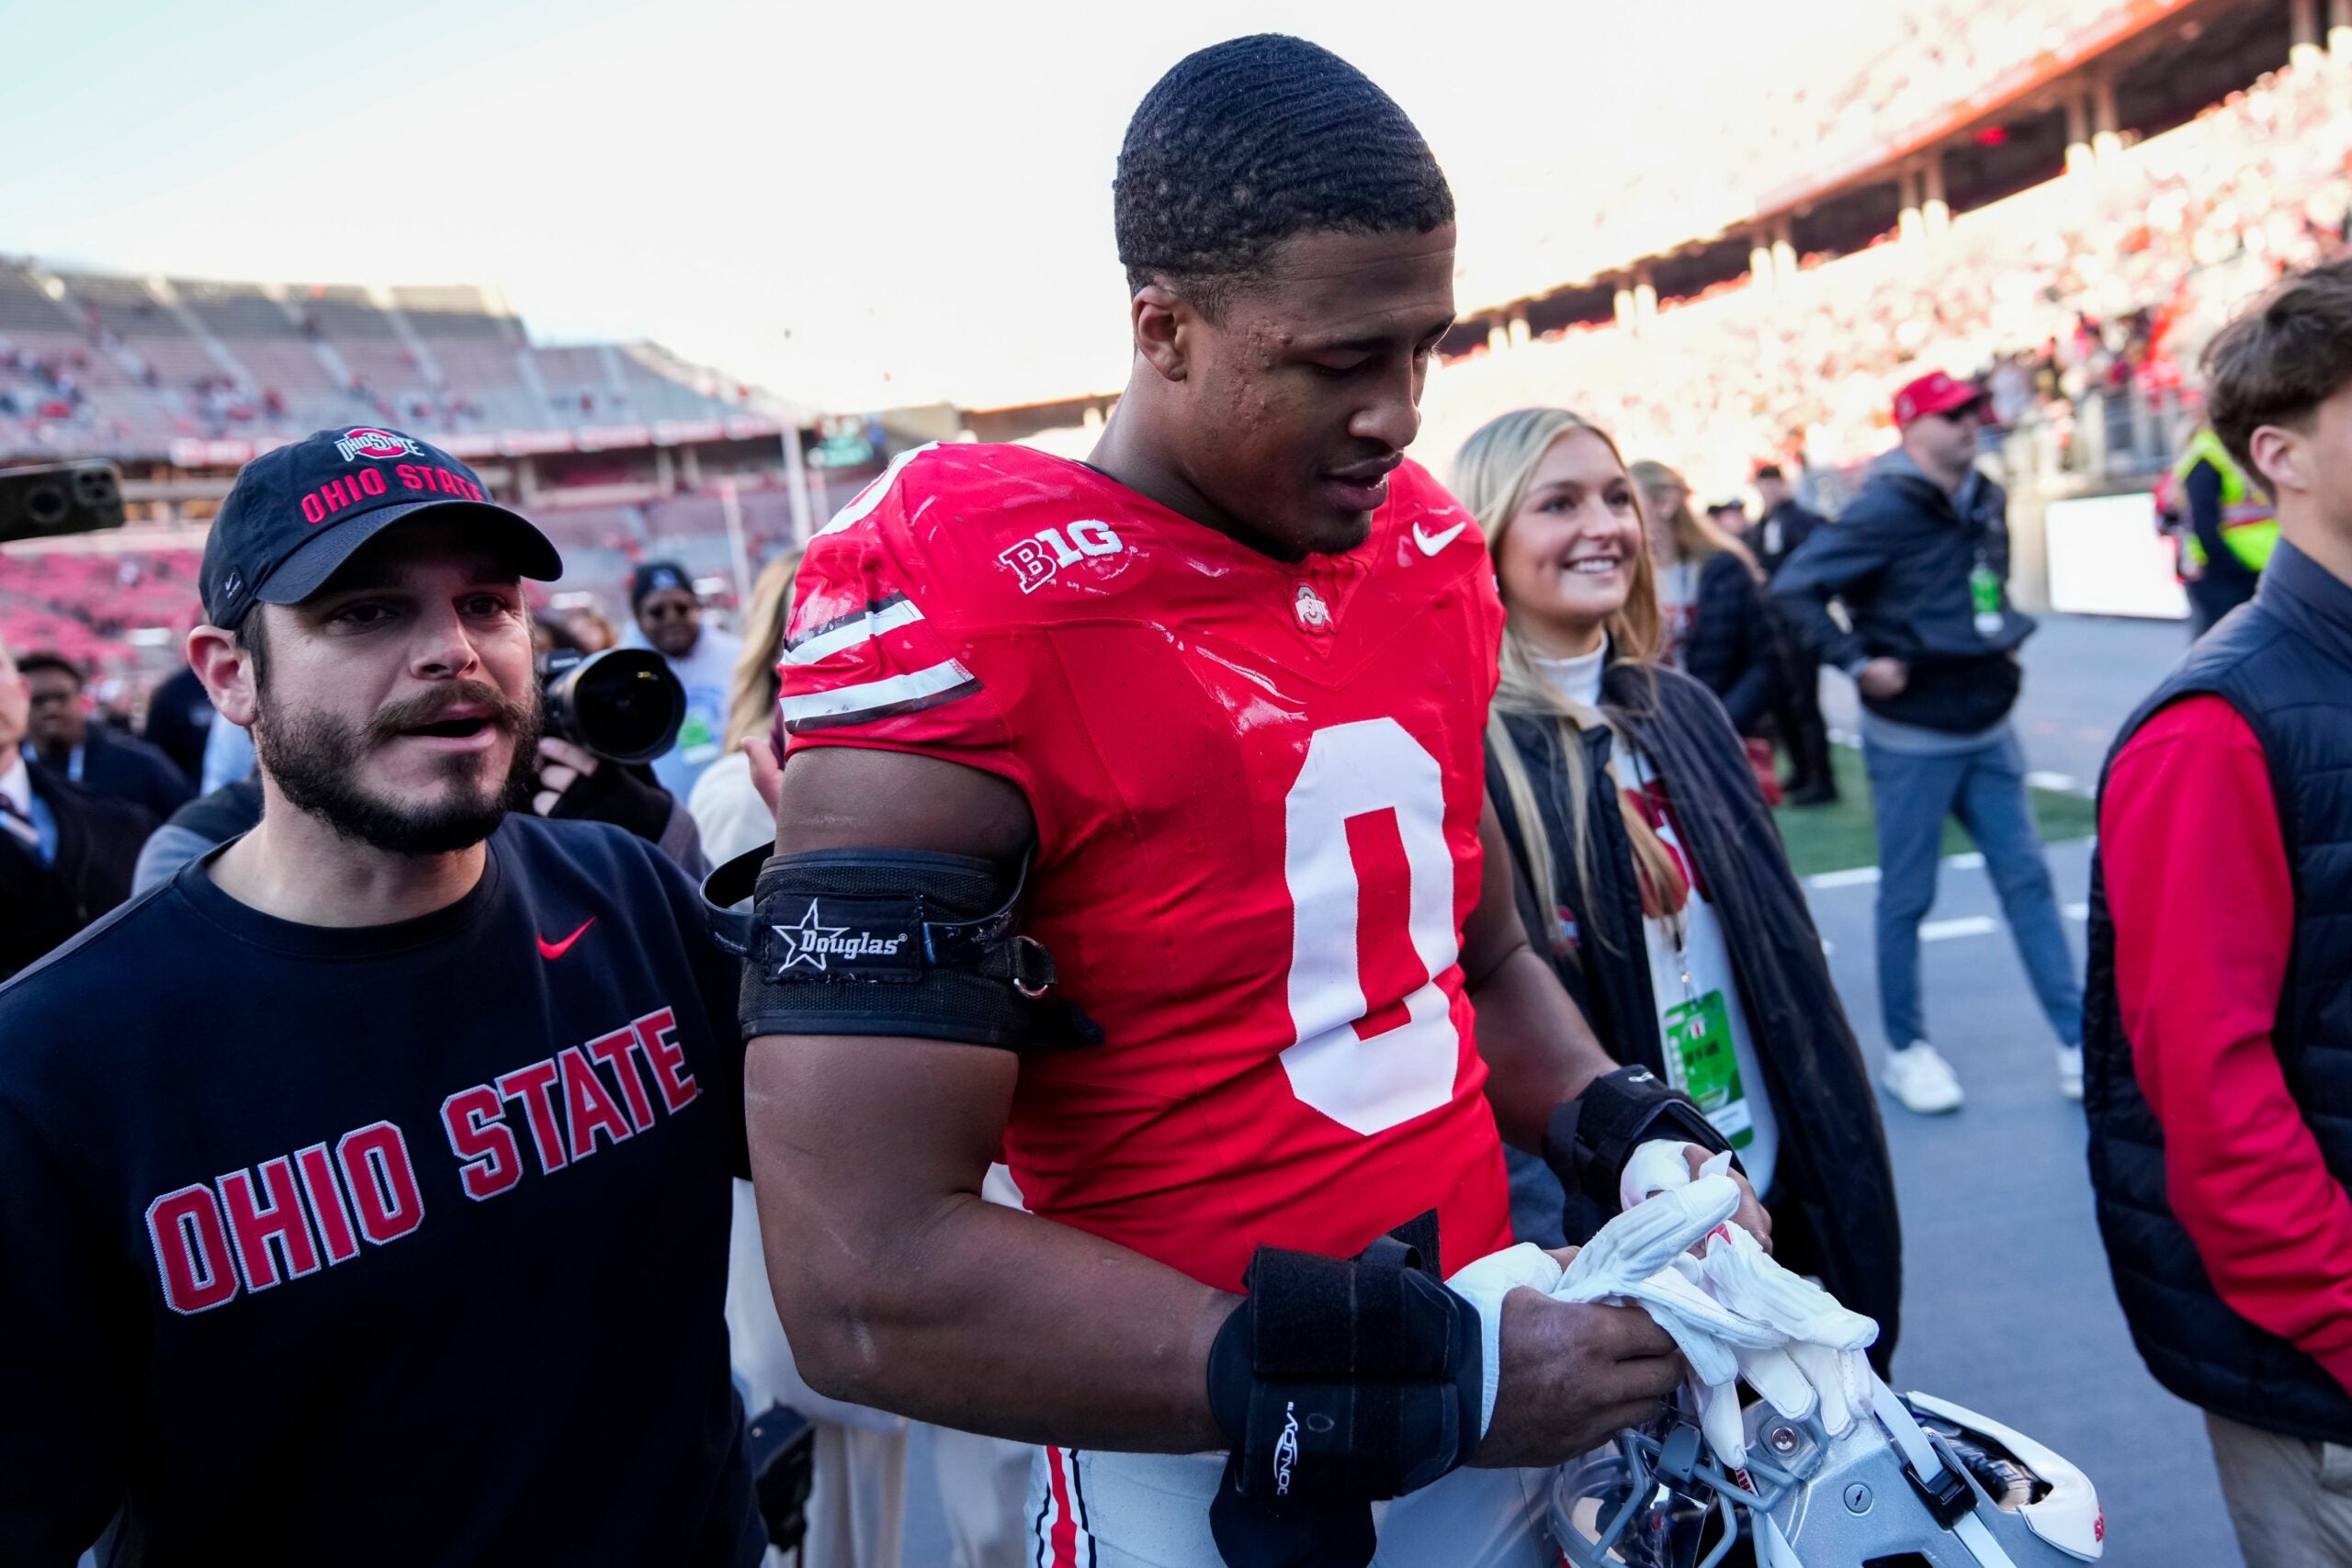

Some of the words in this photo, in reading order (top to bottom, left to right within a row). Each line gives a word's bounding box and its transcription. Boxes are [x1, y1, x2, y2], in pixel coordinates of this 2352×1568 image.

[301, 468, 387, 524] OHIO
[396, 464, 482, 502] STATE
[798, 929, 899, 960] Douglas
[145, 1120, 425, 1316] OHIO
[439, 1006, 698, 1202] STATE
